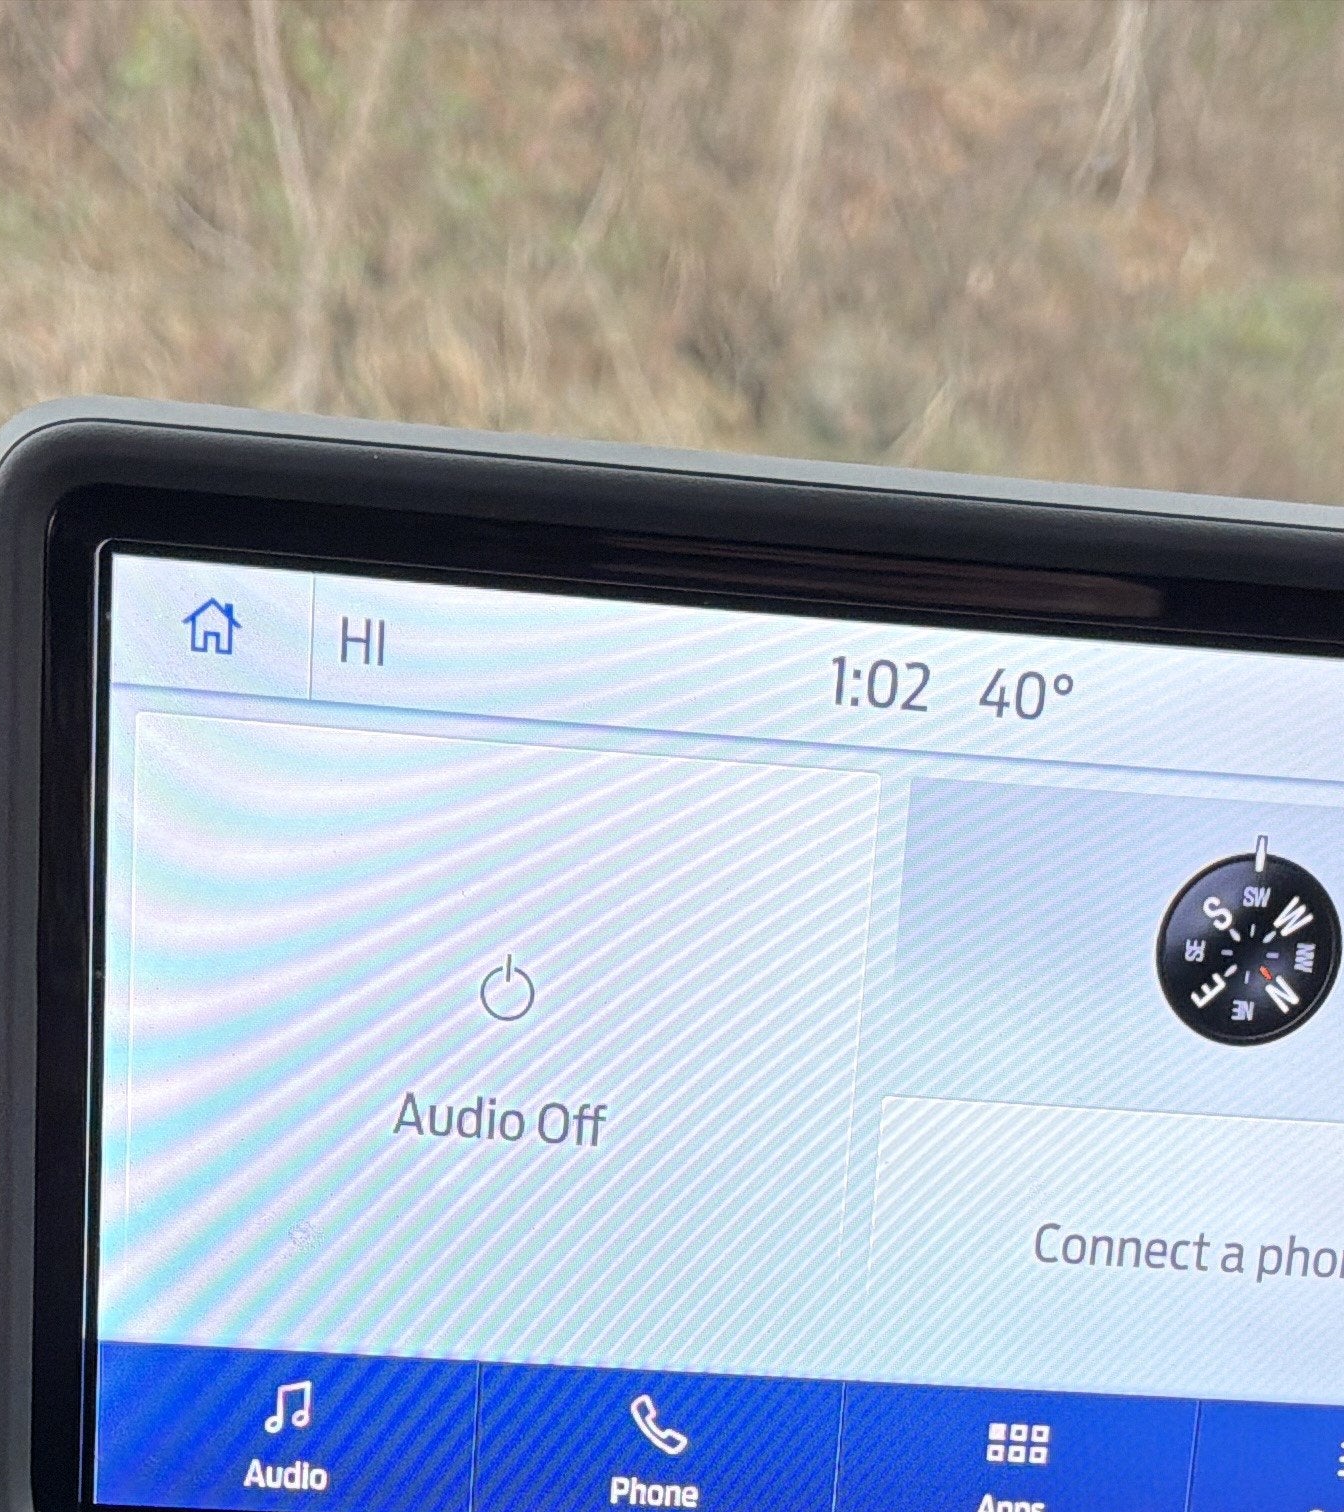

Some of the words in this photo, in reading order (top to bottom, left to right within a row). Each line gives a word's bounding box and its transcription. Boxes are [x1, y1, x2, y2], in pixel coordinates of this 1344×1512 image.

[340, 616, 385, 666] HI
[829, 655, 930, 712] 1:02
[978, 667, 1075, 720] 40°
[1203, 896, 1232, 930] S
[1243, 886, 1271, 907] SW
[1273, 895, 1313, 936] W
[1185, 939, 1206, 962] SE
[1294, 942, 1316, 973] NW
[1190, 972, 1226, 1008] E
[1265, 975, 1300, 1014] N
[1231, 999, 1255, 1021] NE
[393, 1091, 525, 1143] Audio
[537, 1101, 608, 1148] Off
[1034, 1222, 1209, 1272] Connect
[1220, 1241, 1245, 1273] a
[243, 1457, 328, 1492] Audio
[610, 1475, 700, 1510] Phone
